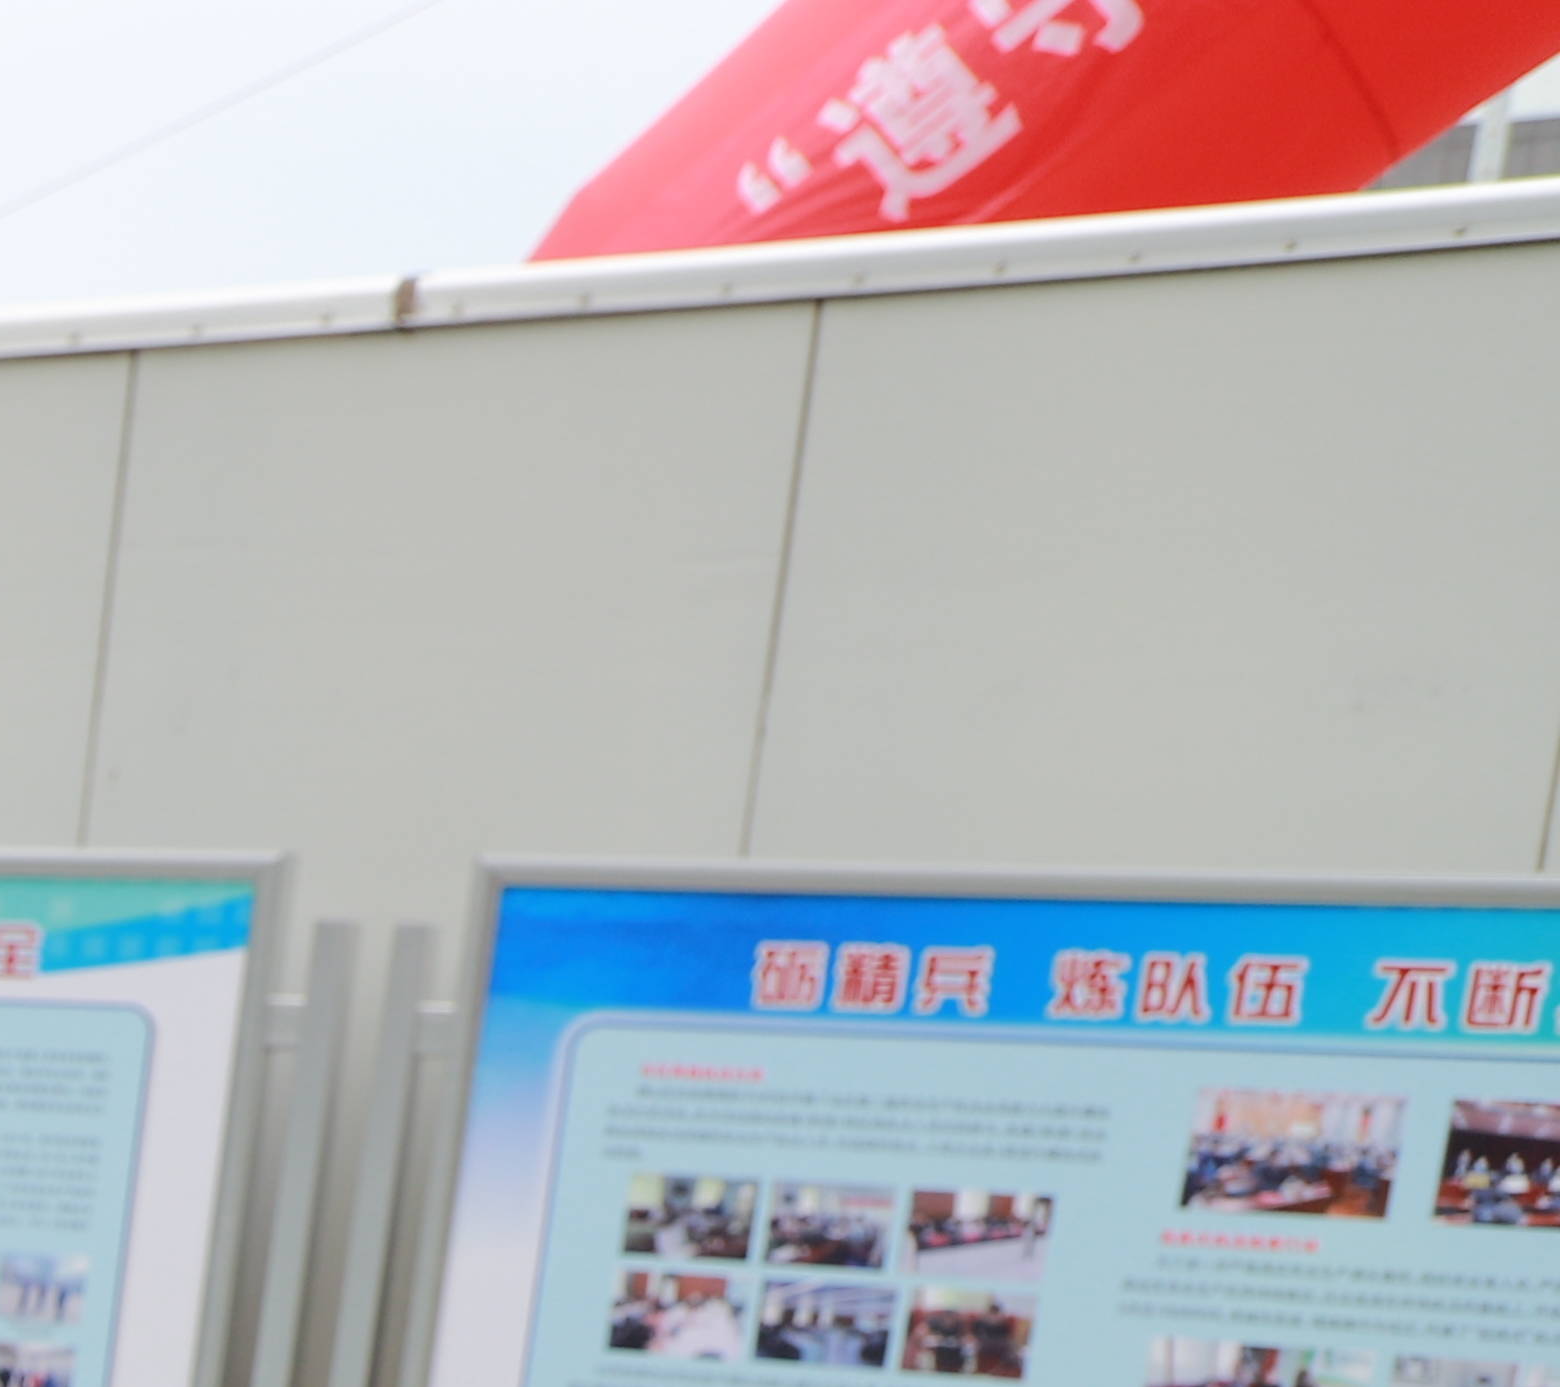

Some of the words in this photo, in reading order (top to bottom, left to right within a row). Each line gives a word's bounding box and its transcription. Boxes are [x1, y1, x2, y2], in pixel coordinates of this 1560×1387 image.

[752, 939, 994, 1017] 砺精兵
[1047, 948, 1309, 1025] 炼队伍
[1364, 957, 1560, 1034] 不断
